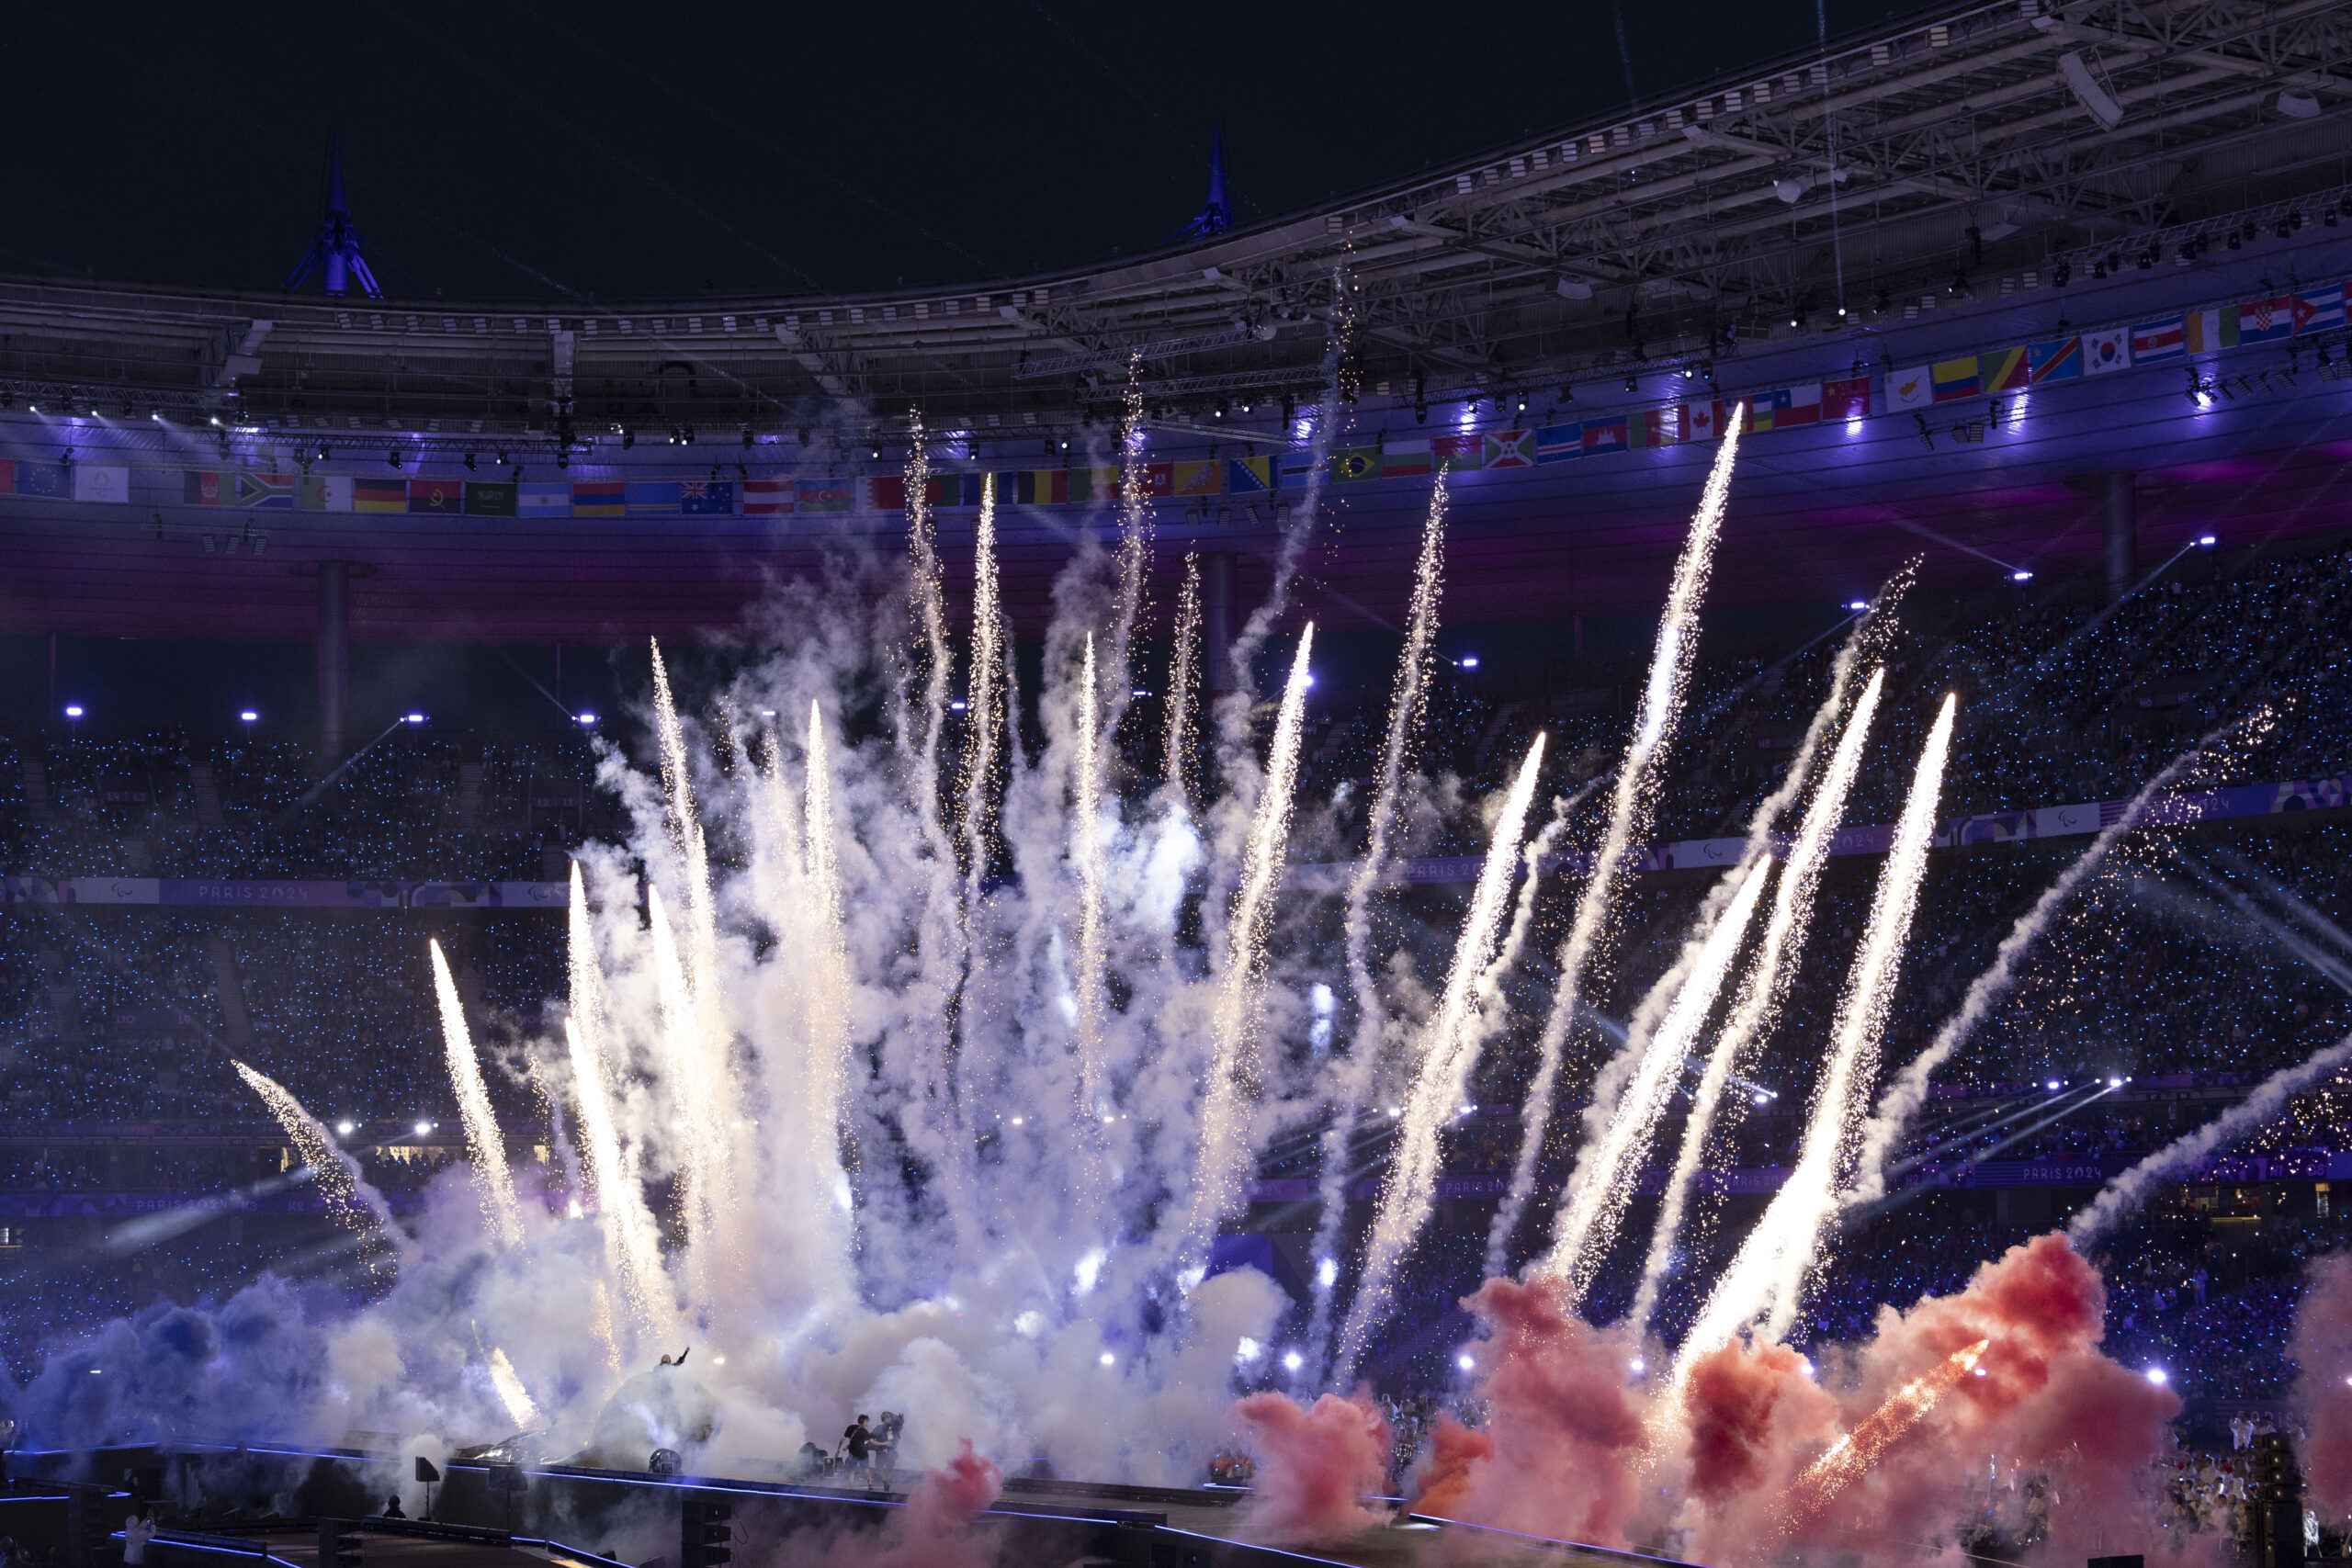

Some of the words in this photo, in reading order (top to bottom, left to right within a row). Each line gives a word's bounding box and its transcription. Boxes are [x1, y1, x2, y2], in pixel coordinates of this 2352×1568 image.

[199, 886, 253, 898] PARIS
[260, 886, 308, 900] 2024
[2066, 1167, 2102, 1179] 2024
[188, 1199, 228, 1210] 2024
